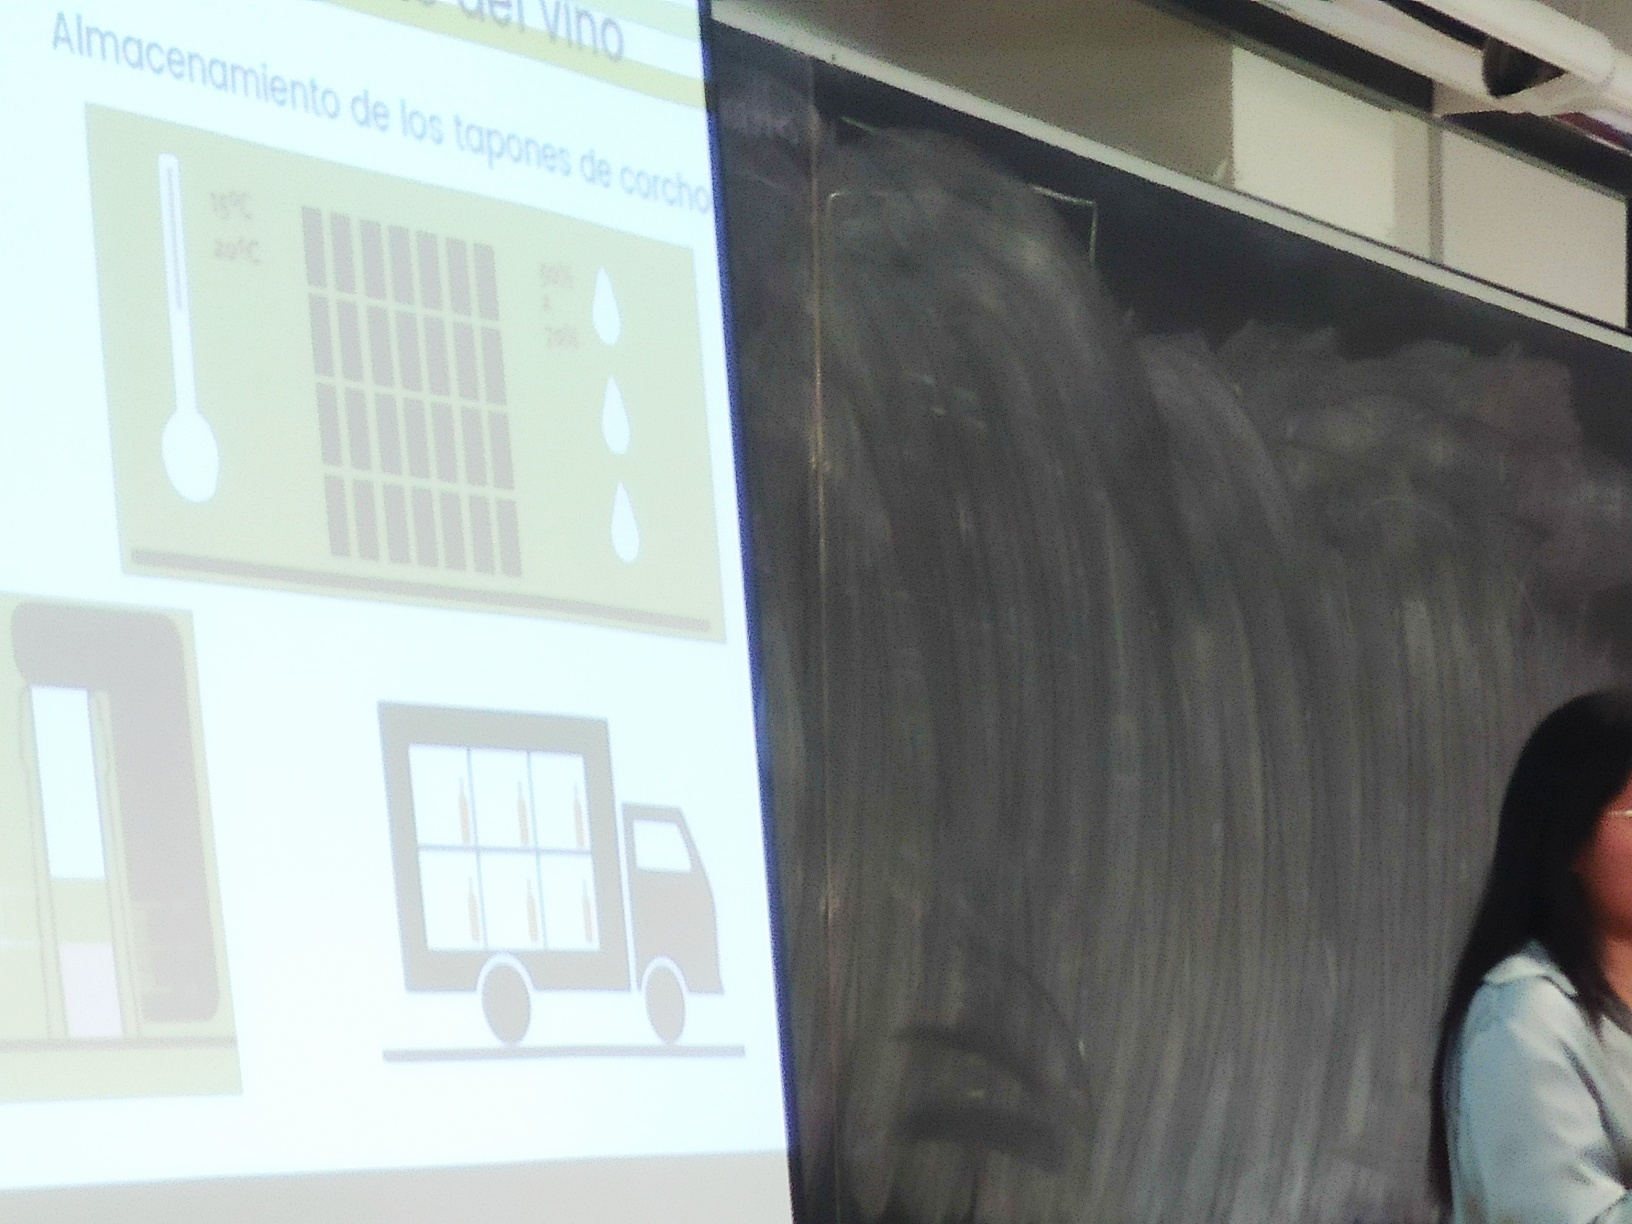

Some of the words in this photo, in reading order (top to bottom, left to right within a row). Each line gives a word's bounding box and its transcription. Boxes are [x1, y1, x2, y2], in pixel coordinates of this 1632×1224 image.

[538, 0, 625, 62] vino
[53, 11, 341, 120] Almacenamiento
[350, 88, 391, 134] de
[399, 98, 445, 147] los
[453, 112, 572, 178] tapones
[579, 148, 613, 189] de
[619, 164, 713, 216] corcho
